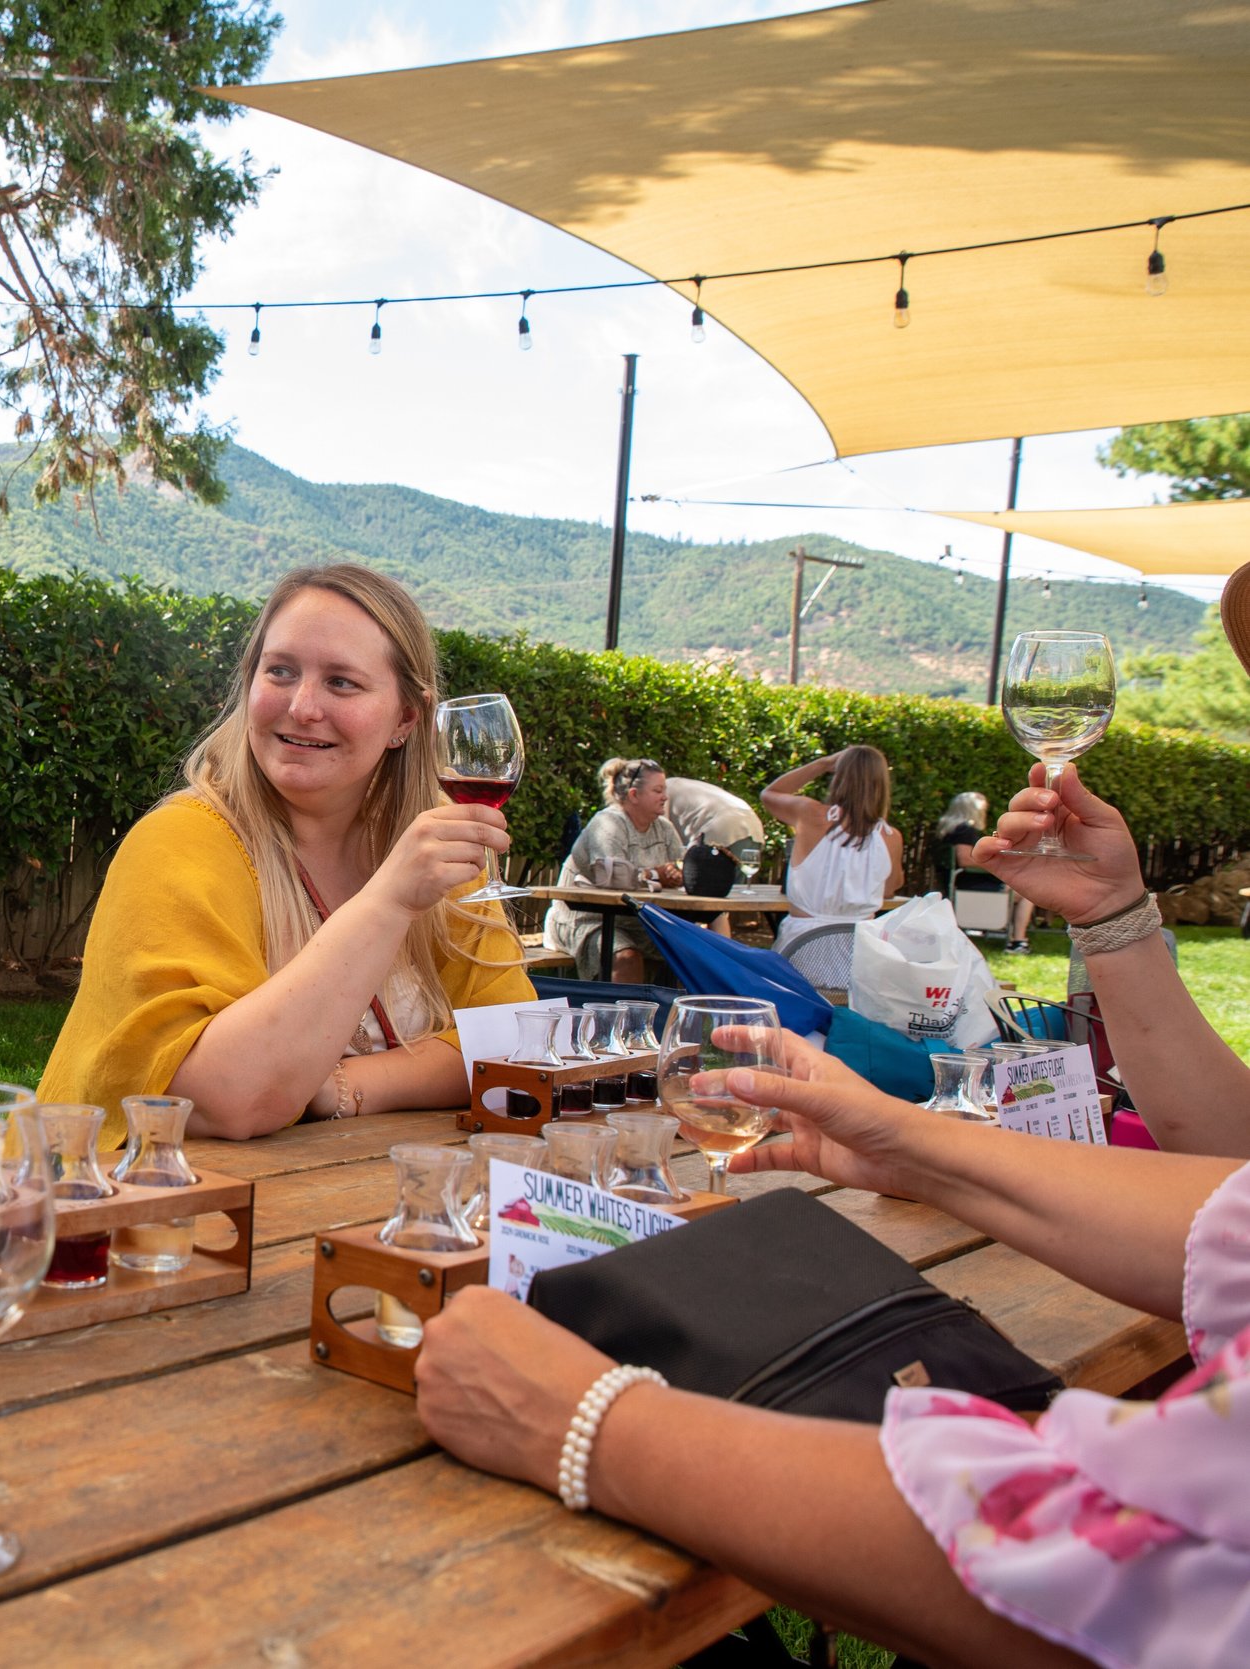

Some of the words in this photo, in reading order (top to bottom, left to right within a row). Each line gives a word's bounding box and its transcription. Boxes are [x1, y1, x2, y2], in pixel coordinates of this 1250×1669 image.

[1007, 1063, 1030, 1086] SUMMER
[1030, 1060, 1049, 1081] WHITES
[1049, 1057, 1066, 1077] FLIGHT
[523, 1171, 584, 1215] SUMMER
[587, 1190, 633, 1232] WHITES
